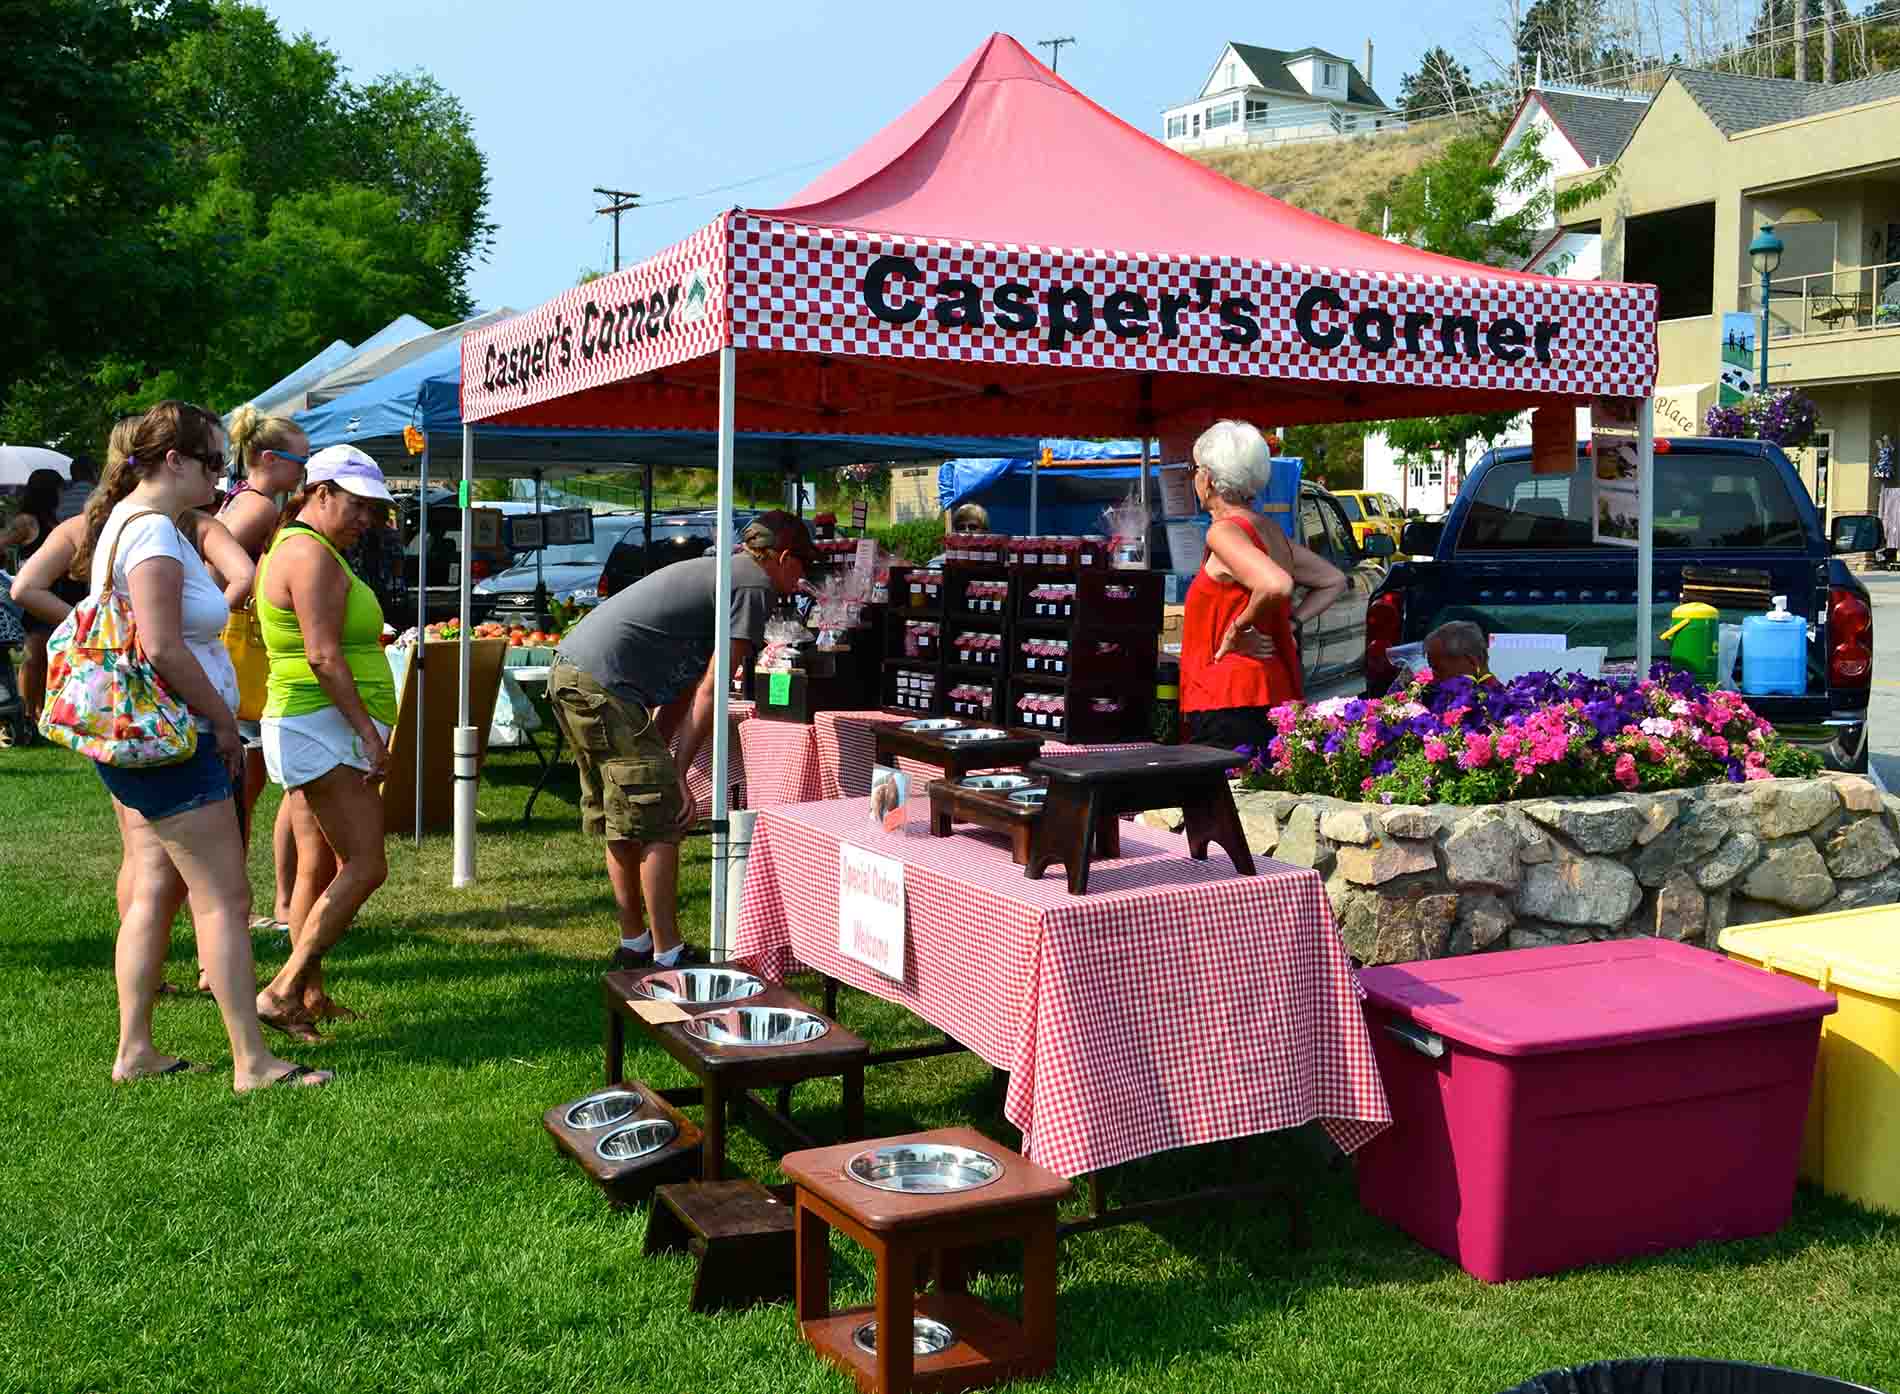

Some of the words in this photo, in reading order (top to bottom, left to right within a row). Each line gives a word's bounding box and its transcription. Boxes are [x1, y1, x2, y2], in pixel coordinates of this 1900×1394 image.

[483, 315, 573, 395] Casper's
[581, 284, 680, 360] Corner
[863, 256, 1260, 351] Casper's
[1295, 286, 1561, 363] Corner
[1655, 396, 1694, 432] Place
[872, 864, 899, 908] Orders
